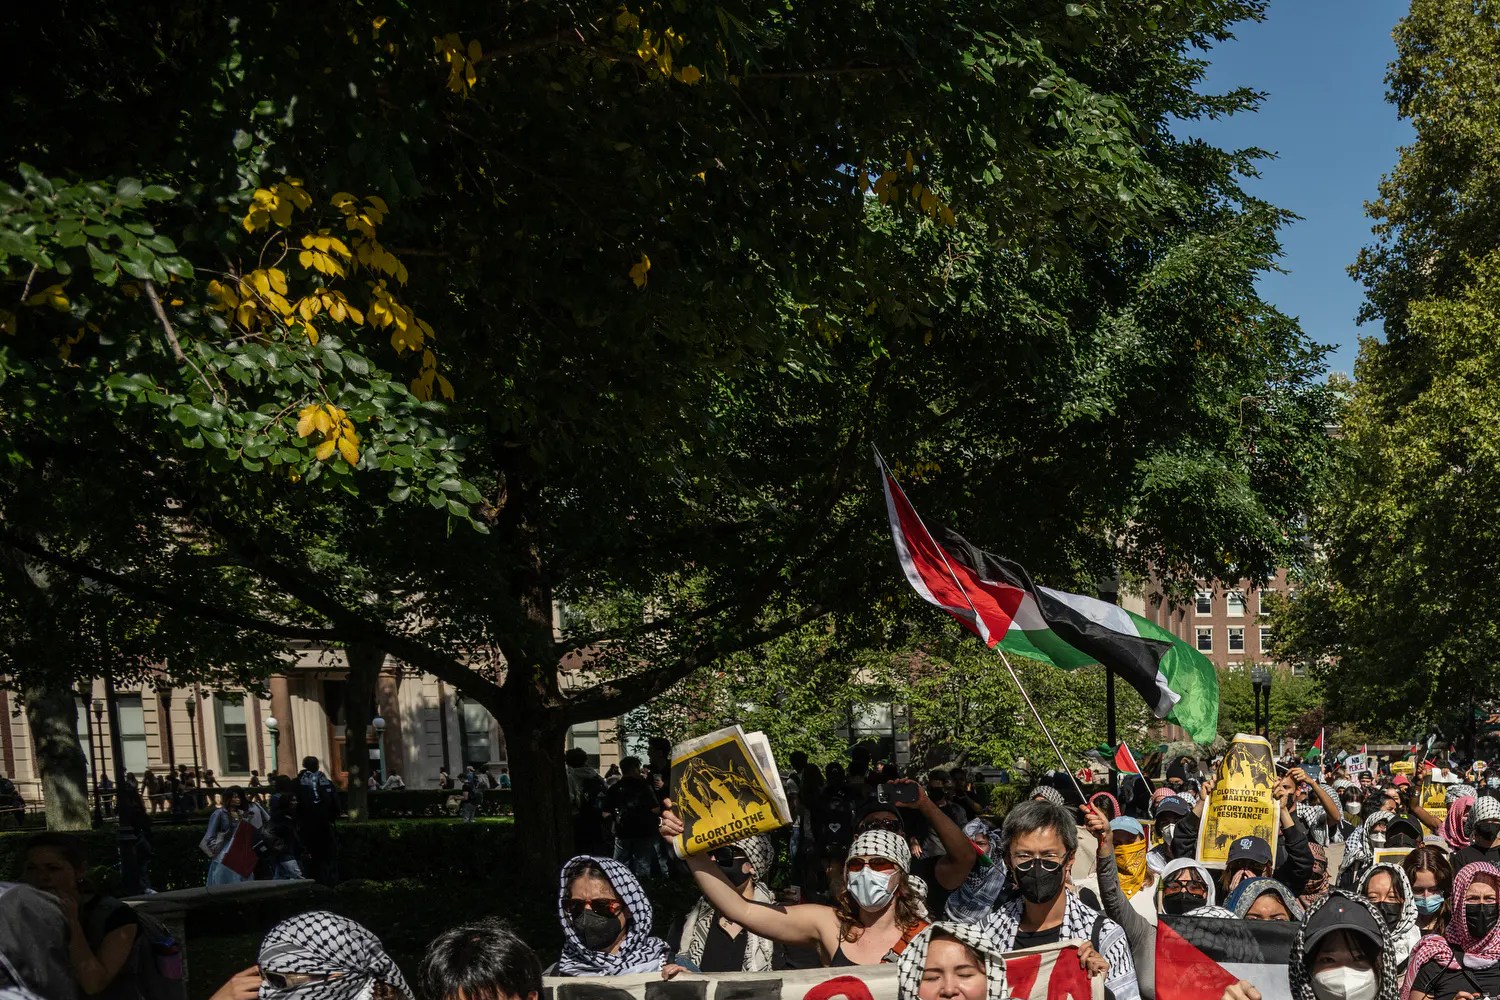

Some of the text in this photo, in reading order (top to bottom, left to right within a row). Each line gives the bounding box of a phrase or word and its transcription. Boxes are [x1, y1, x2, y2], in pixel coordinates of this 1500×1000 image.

[1349, 763, 1364, 772] PEACE
[1216, 788, 1266, 798] GLORY TO THE
[1221, 795, 1259, 803] MARTYRS
[1212, 804, 1269, 815] VICTORY TO THE
[1216, 811, 1263, 821] RESISTANCE
[694, 811, 765, 844] GLORY TO THE
[707, 824, 759, 850] MARTYRS
